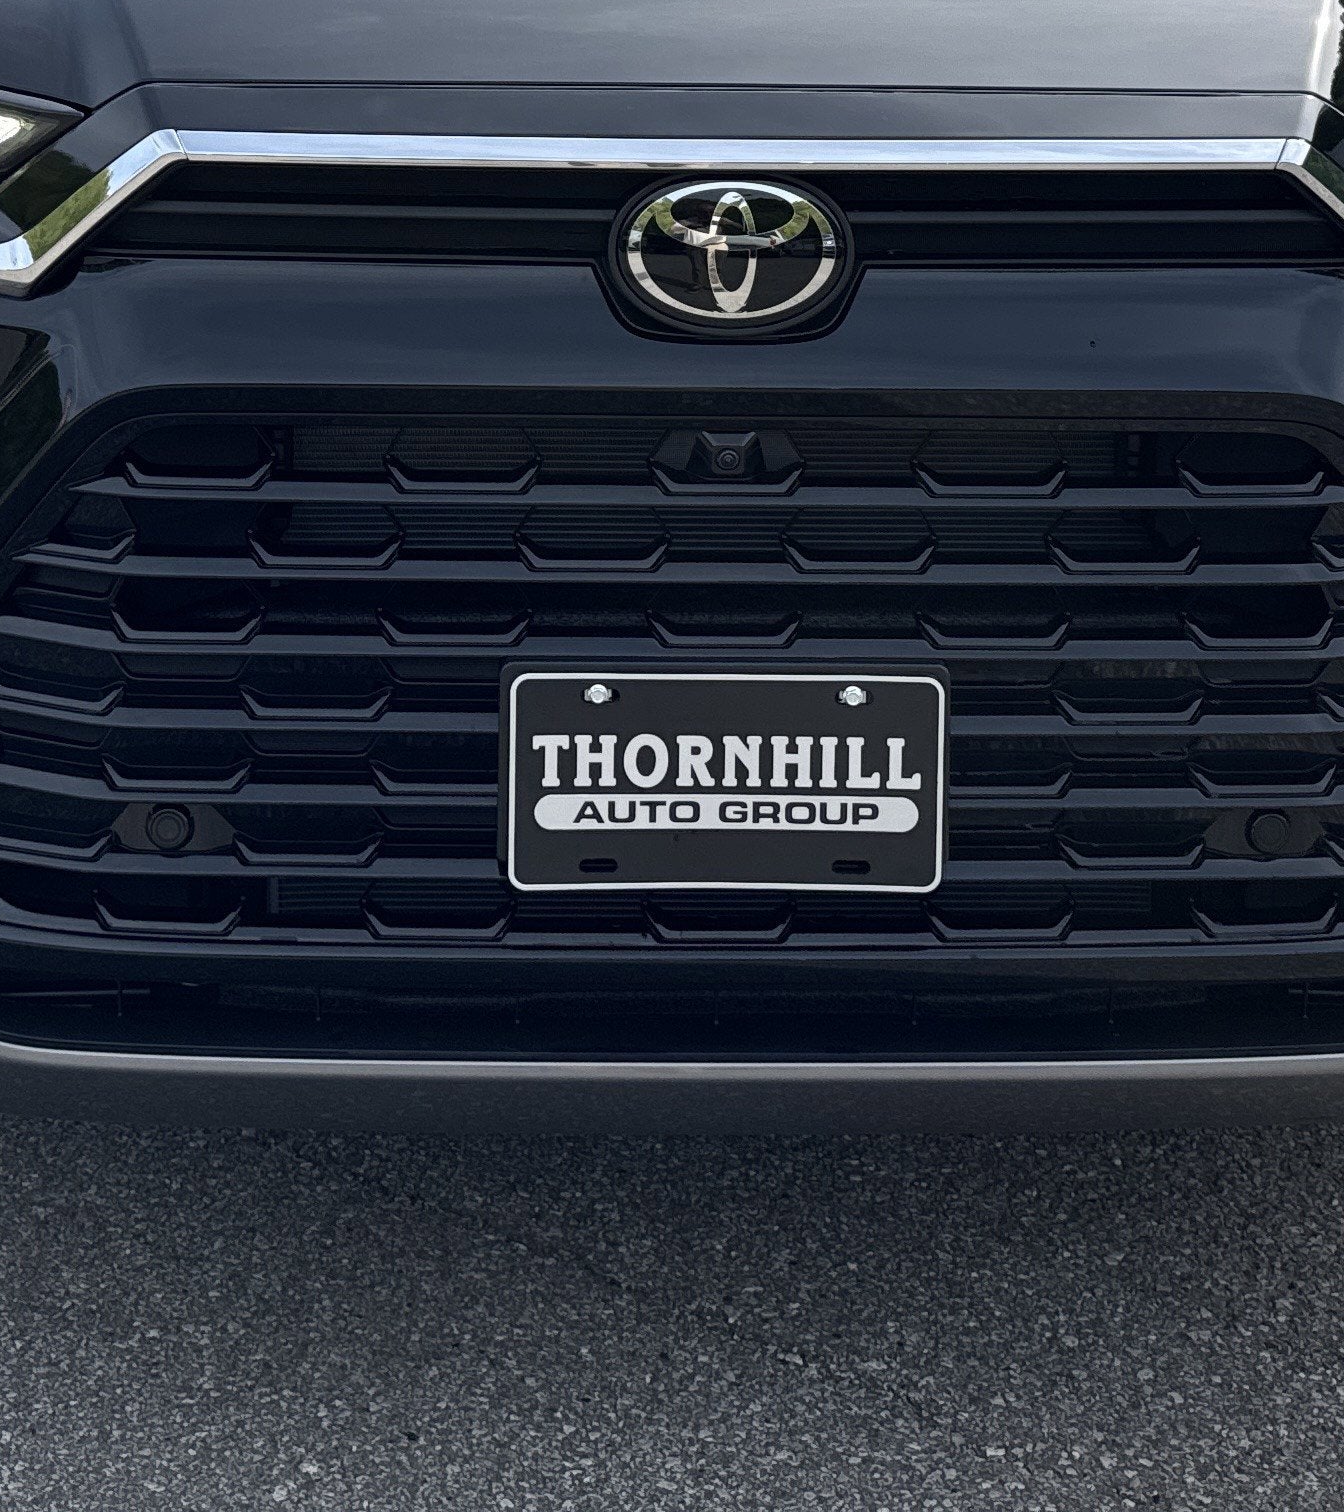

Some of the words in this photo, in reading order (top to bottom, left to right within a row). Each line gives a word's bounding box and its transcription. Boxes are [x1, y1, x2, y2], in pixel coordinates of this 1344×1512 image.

[531, 733, 922, 790] THORNHILL
[572, 800, 702, 824] AUTO
[718, 800, 879, 826] GROUP
